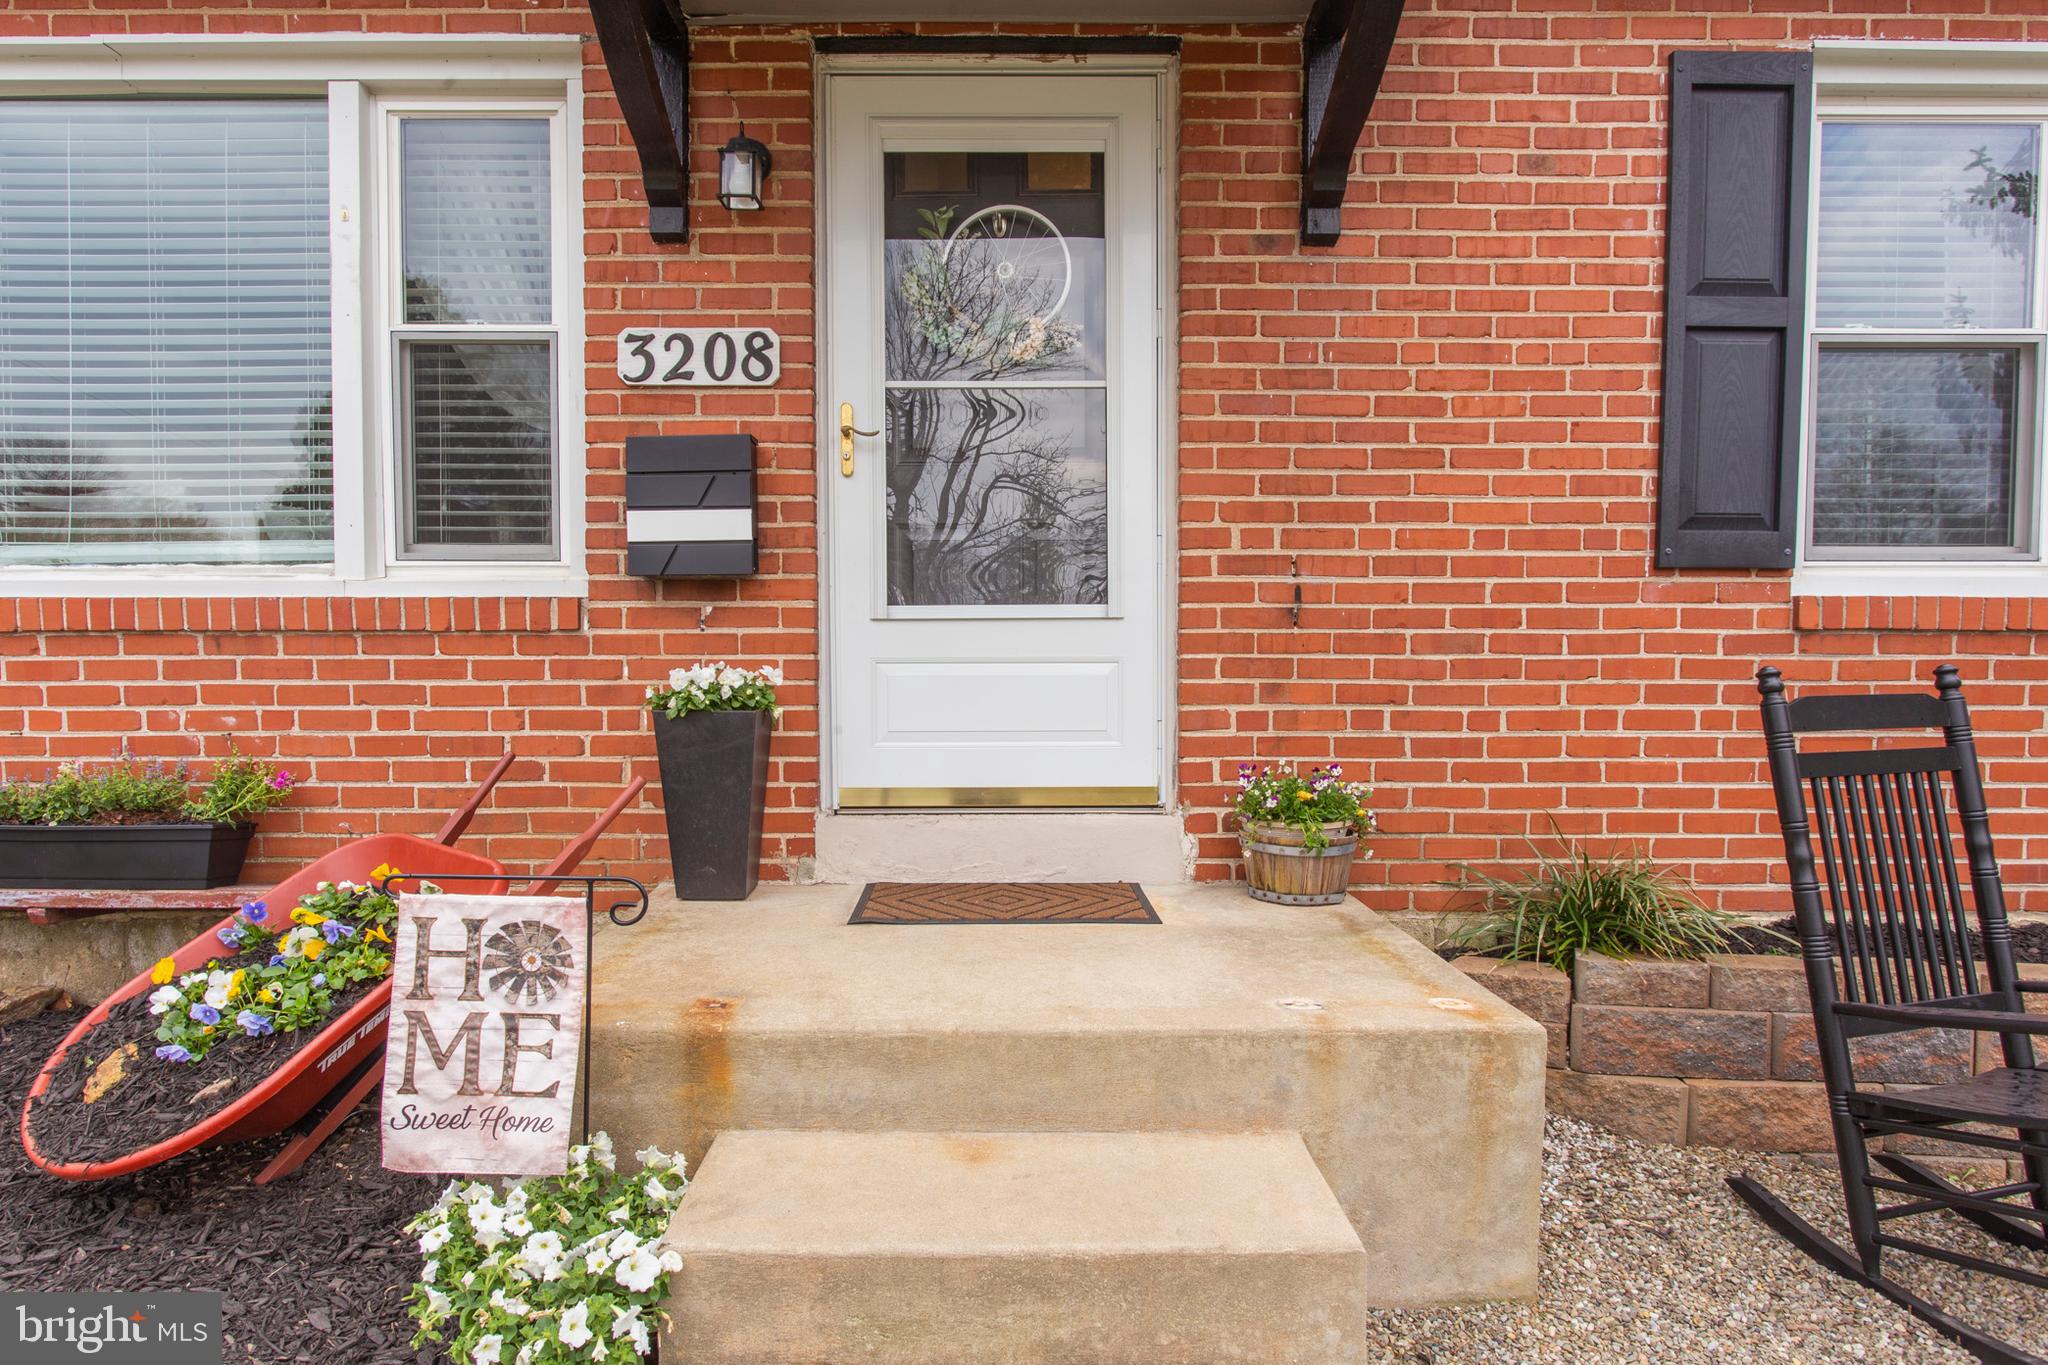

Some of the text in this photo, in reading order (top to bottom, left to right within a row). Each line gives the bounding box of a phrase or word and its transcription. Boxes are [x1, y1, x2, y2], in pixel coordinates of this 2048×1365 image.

[622, 331, 775, 383] 3208
[316, 1032, 357, 1074] TRUE
[396, 1010, 561, 1099] ME
[390, 1103, 554, 1141] Sweet Home
